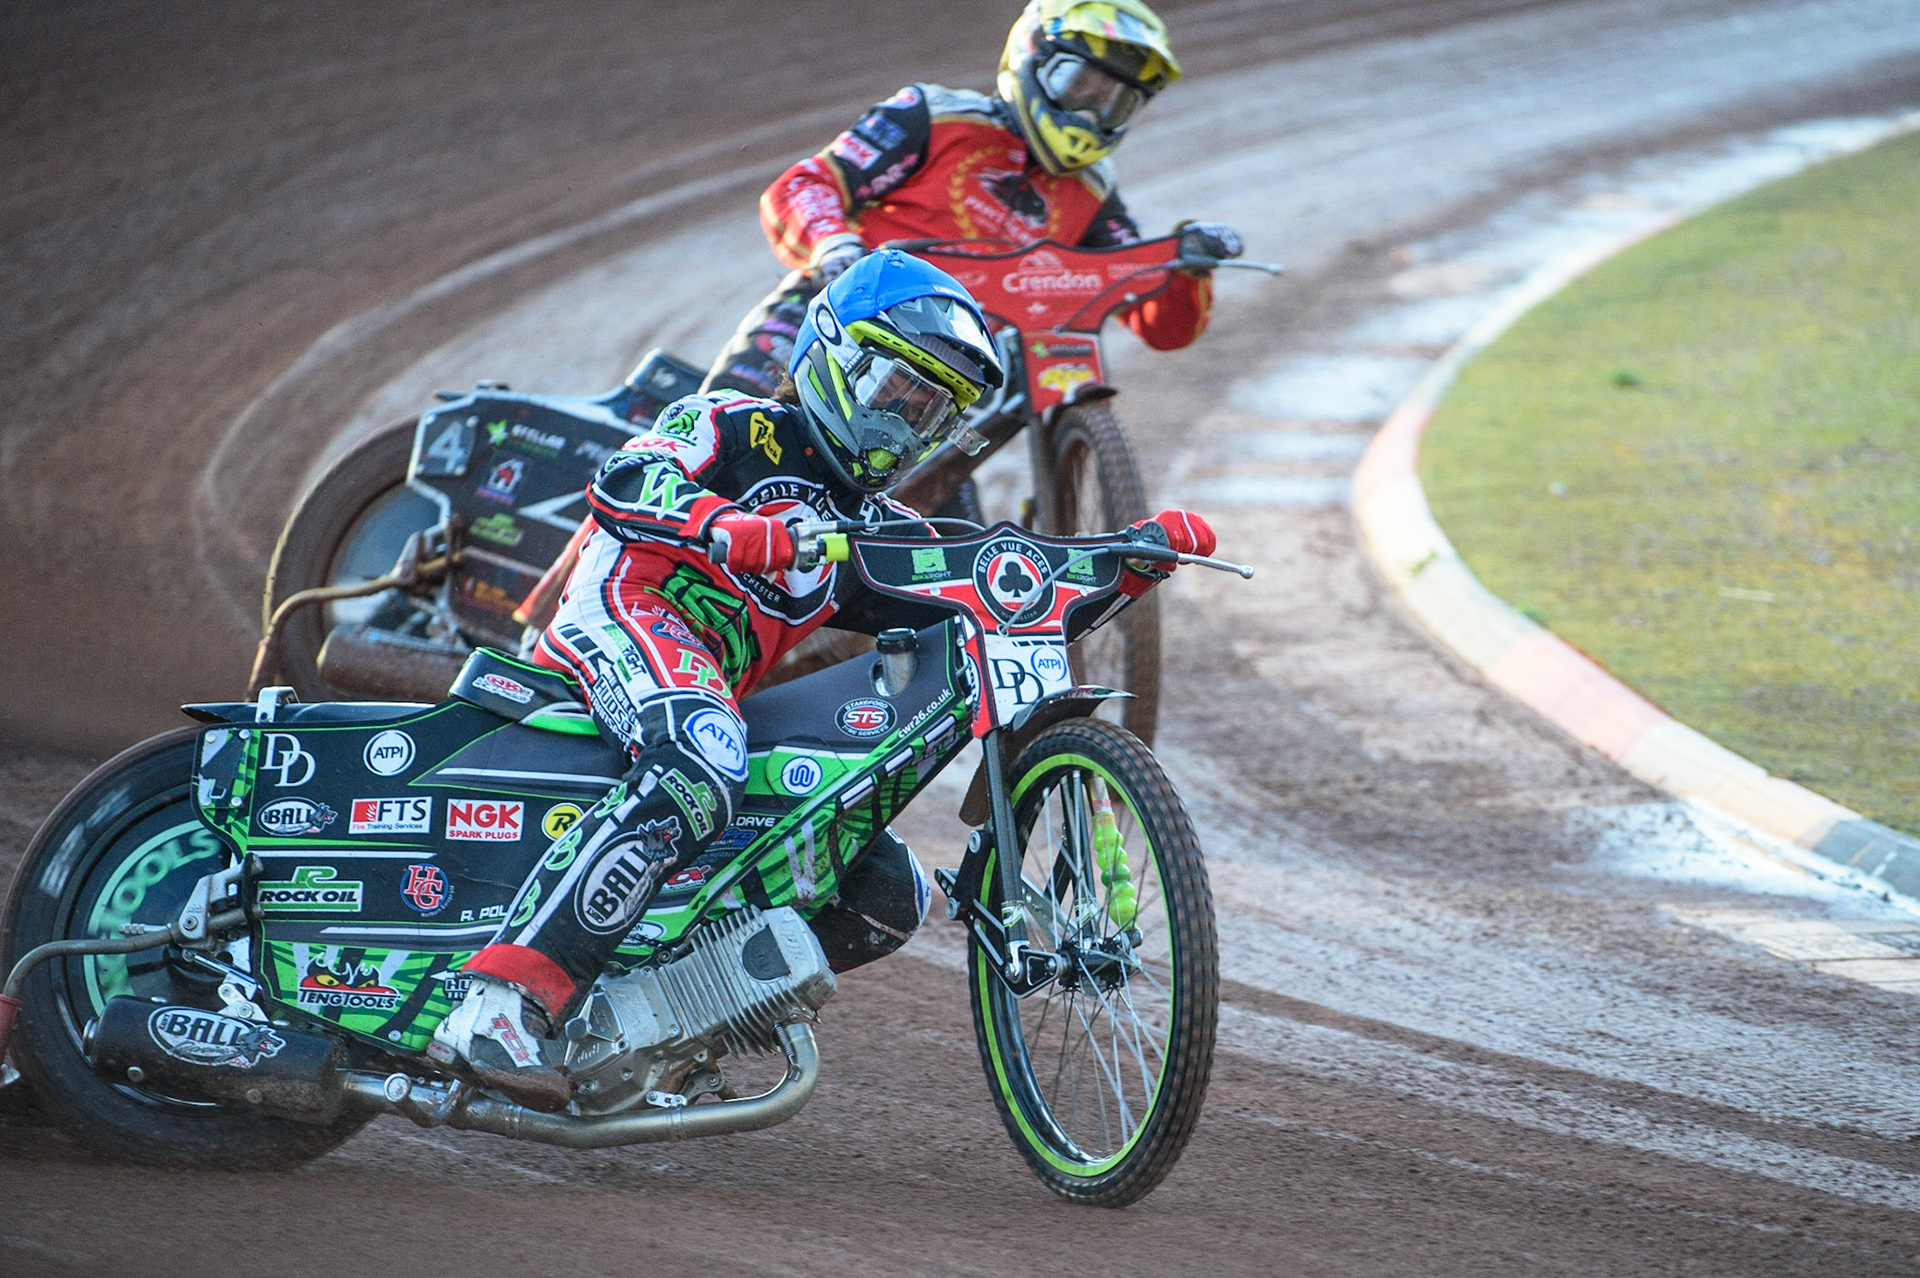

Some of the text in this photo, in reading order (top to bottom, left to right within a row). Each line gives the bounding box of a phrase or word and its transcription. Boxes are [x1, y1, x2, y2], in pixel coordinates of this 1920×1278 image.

[1002, 270, 1101, 293] Crendon
[427, 420, 466, 473] 4
[978, 542, 1048, 574] BELLE VUE ACES
[1037, 658, 1062, 671] ATPI
[844, 699, 889, 711] STAKEFORD
[898, 687, 952, 739] cwr26.co.uk
[846, 710, 885, 724] STS
[857, 724, 890, 737] SERVICES
[697, 721, 743, 762] ATPI
[373, 746, 404, 759] ATPI
[377, 799, 428, 822] FTS
[666, 774, 709, 837] ROCK OIL
[268, 807, 312, 825] BALL
[449, 803, 521, 830] NGK
[367, 823, 393, 831] Training
[448, 830, 519, 840] SPARK PLUGS
[259, 890, 358, 903] ROCK OIL
[300, 989, 397, 1009] TENGTOOLS
[165, 1013, 245, 1046] BALL
